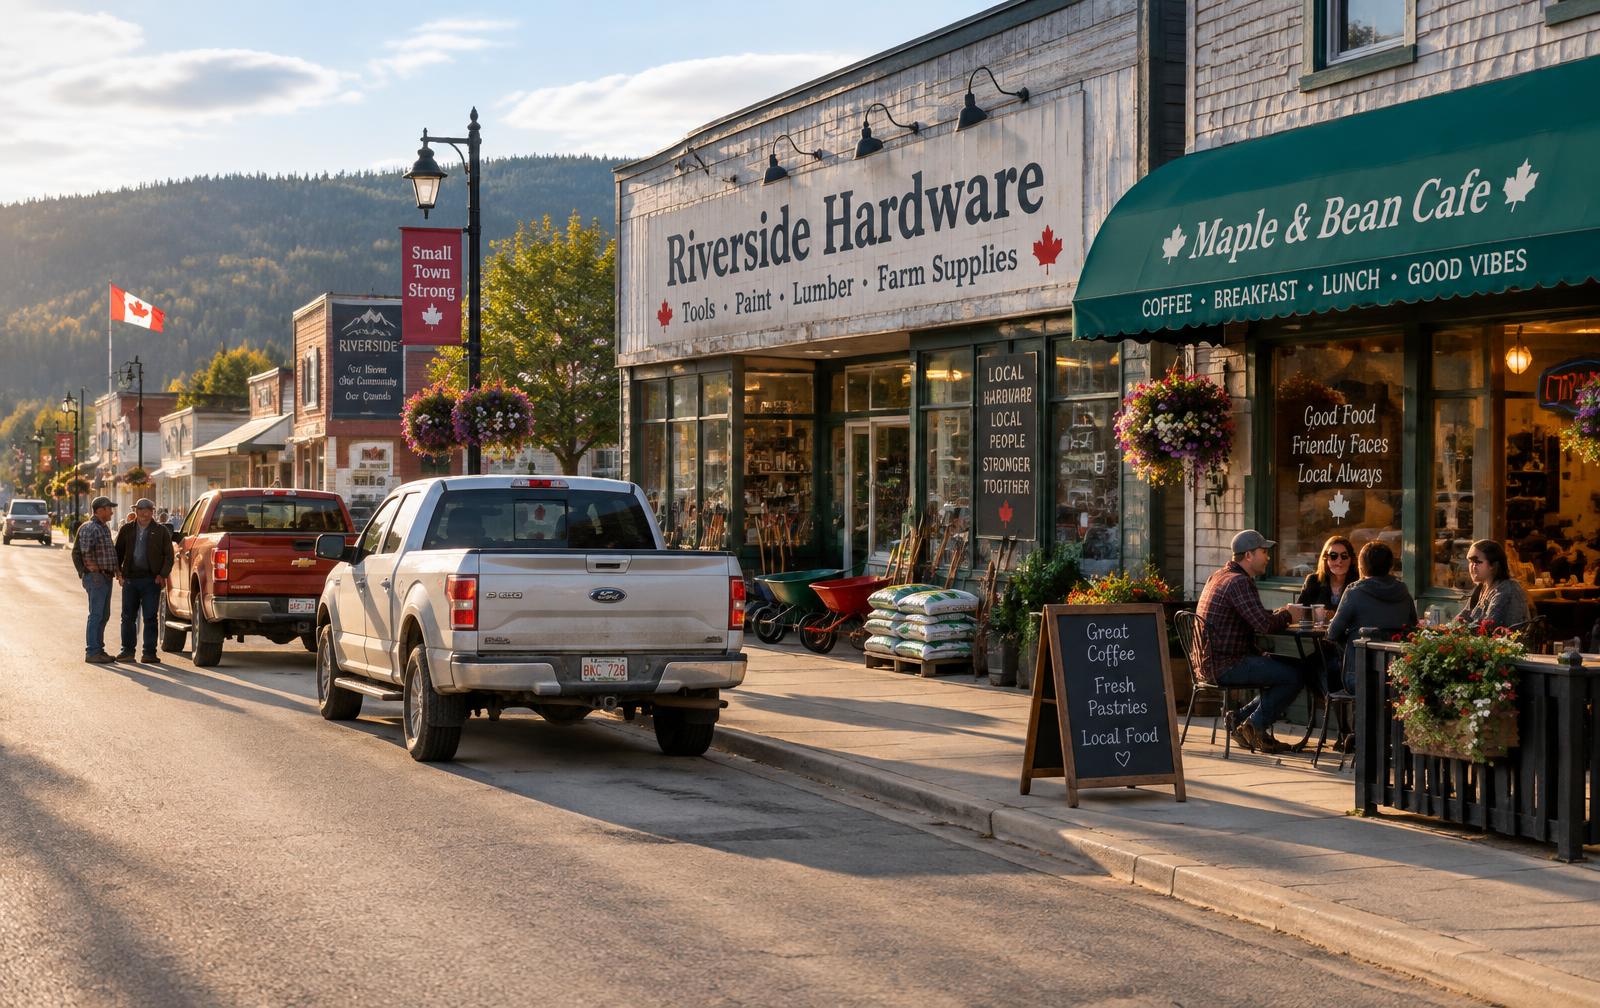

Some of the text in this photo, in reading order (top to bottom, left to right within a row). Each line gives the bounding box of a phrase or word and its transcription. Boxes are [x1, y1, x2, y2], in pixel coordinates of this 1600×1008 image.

[666, 161, 1045, 287] Riverside Hardware
[1188, 168, 1492, 263] Maple & Bean Cafe
[412, 245, 453, 260] Small
[413, 264, 450, 279] Town
[408, 283, 456, 301] Strong
[681, 243, 1018, 324] Tools Paint Lumber Farm Supplies
[1142, 248, 1528, 318] COFFEE BREAKFAST LUNCH GOOD VIBES
[339, 340, 398, 352] RIVERSIDE
[988, 364, 1025, 383] LOCAL
[991, 411, 1023, 428] LOCAL
[1304, 403, 1376, 430] Good Food
[989, 433, 1026, 449] PEOPLE
[1292, 433, 1389, 459] Friendly Faces
[983, 456, 1031, 473] STRONGER
[1298, 463, 1382, 488] Local Always
[1086, 622, 1130, 640] Great
[1087, 644, 1136, 667] Coffee
[1094, 676, 1136, 695] Fresh
[1088, 698, 1148, 717] Pastries
[1081, 726, 1159, 746] Local Food
